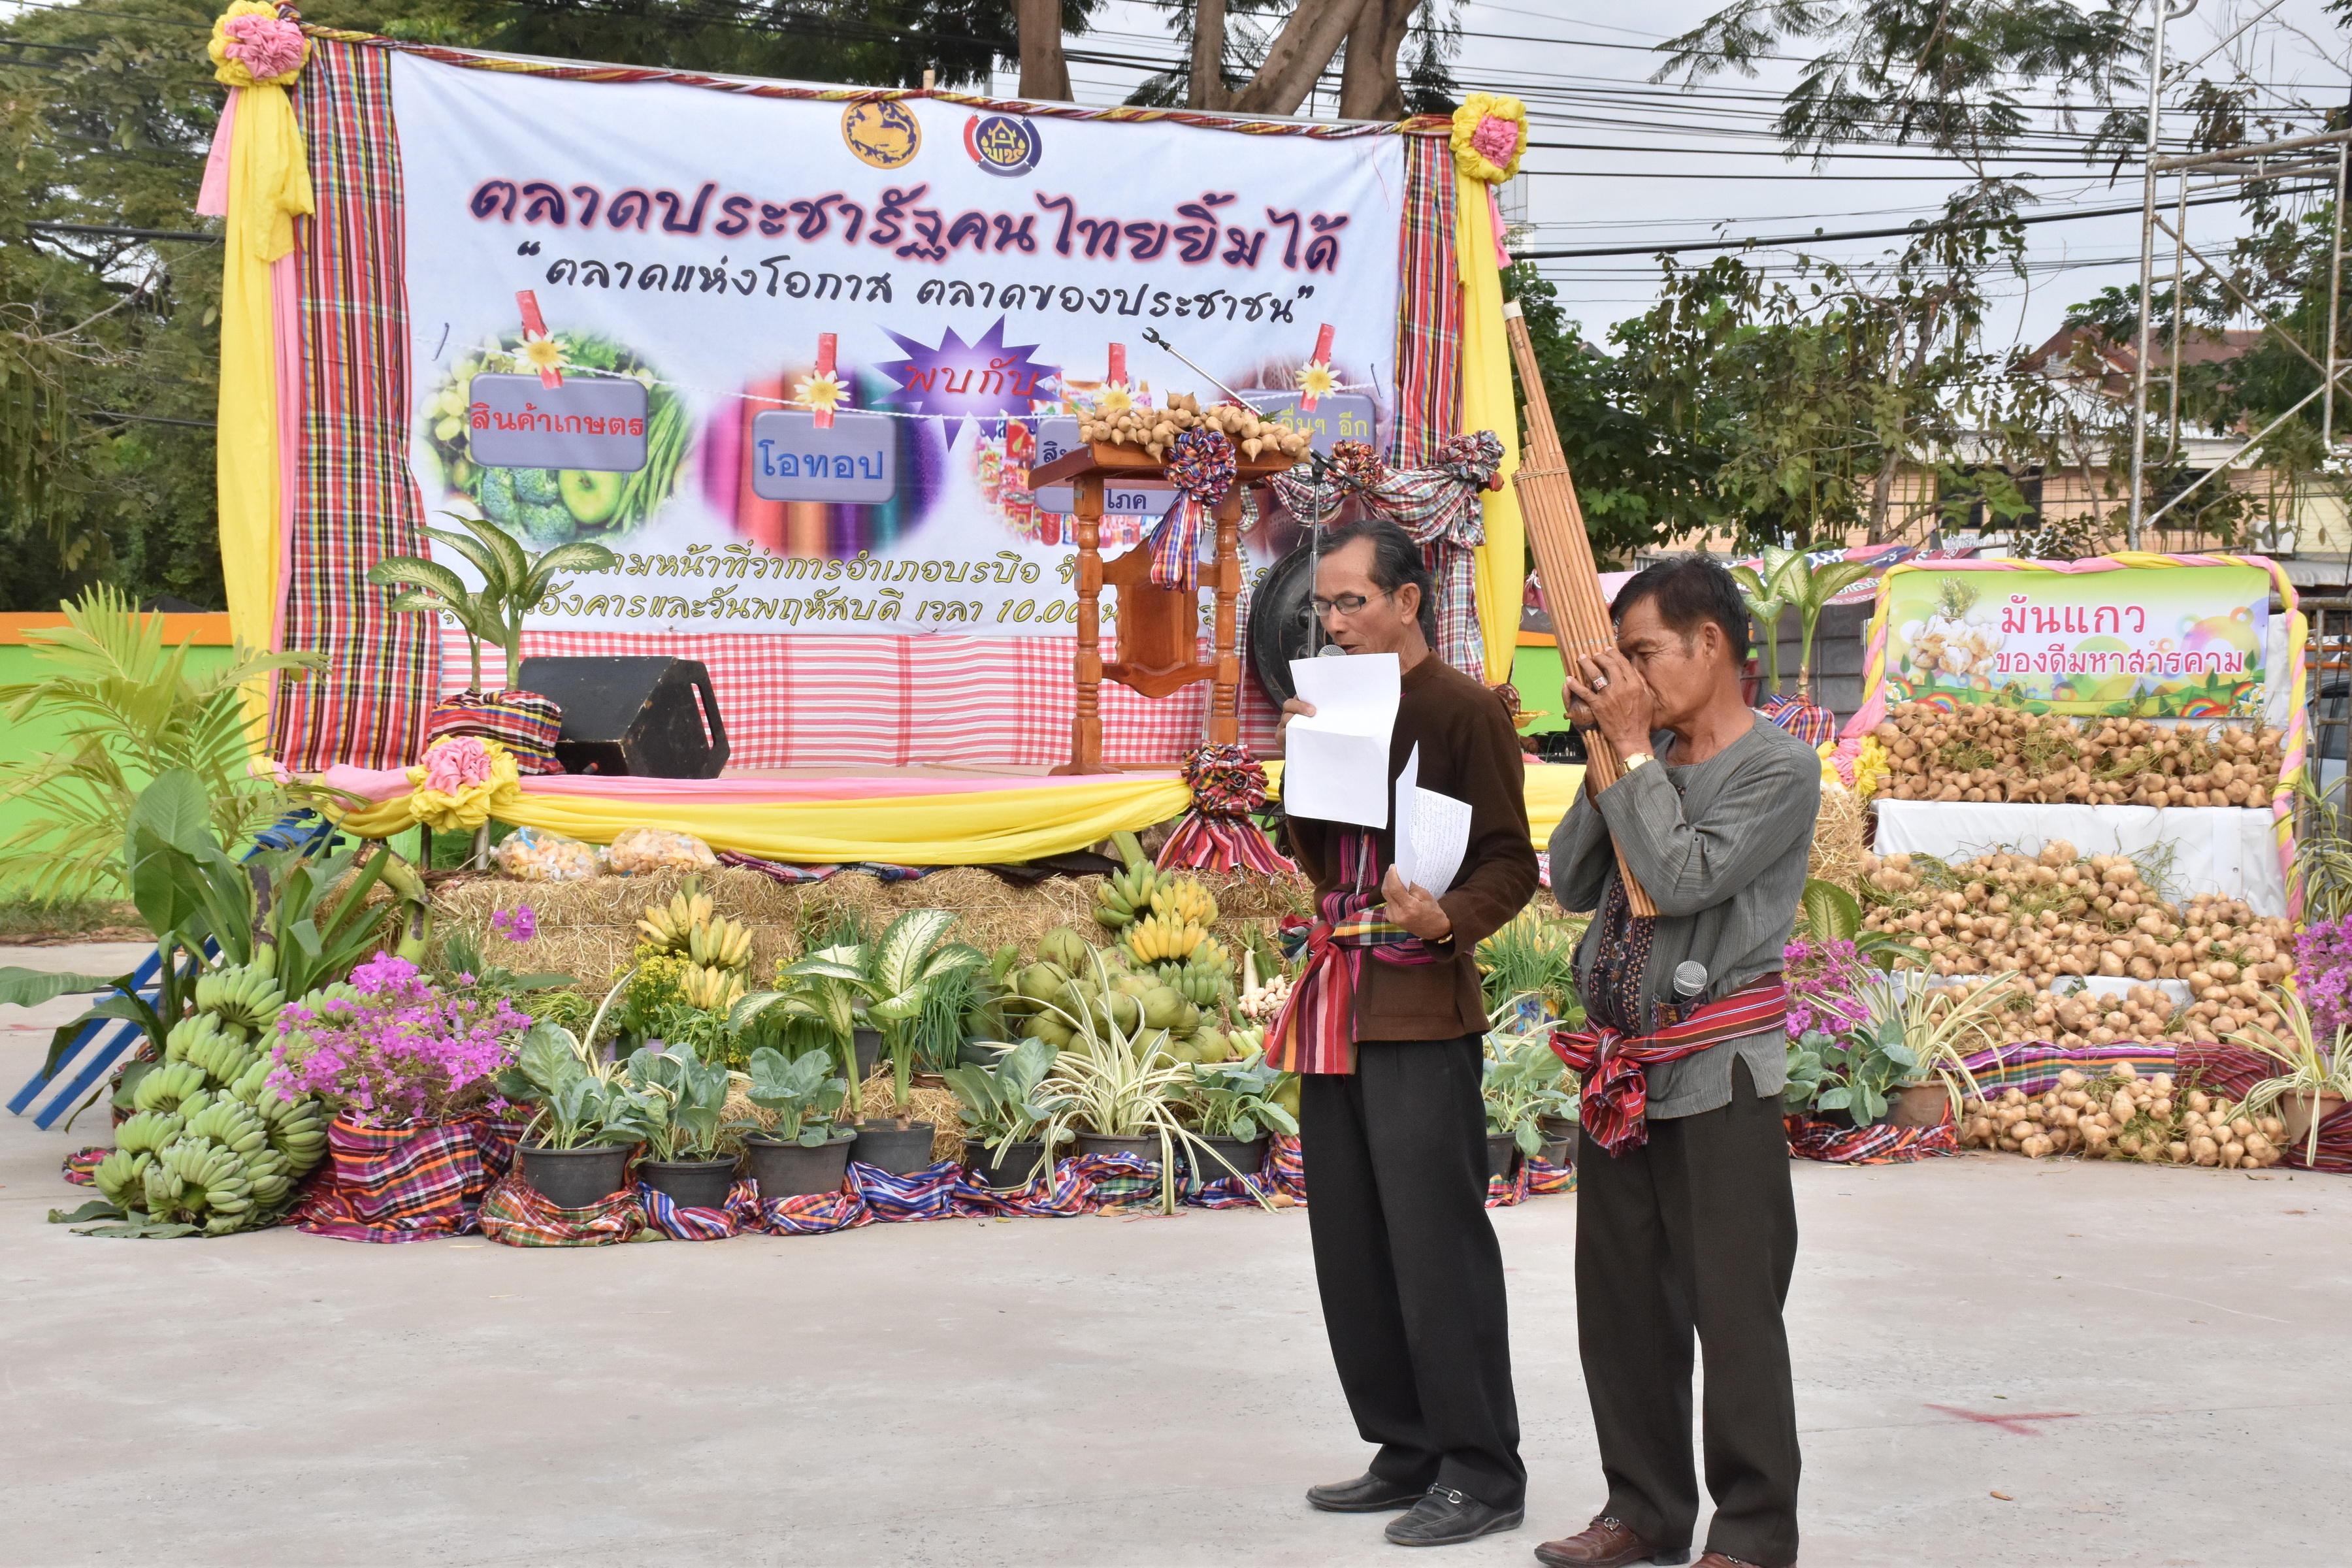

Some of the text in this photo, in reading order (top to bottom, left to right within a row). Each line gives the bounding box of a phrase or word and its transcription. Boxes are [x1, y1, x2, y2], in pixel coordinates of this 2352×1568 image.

[470, 180, 1348, 270] ตลาดประชารัฐคนไทยยิ้มได้
[906, 355, 1040, 396] พบกับ
[470, 402, 644, 436] สินค้าเกษตร
[1339, 411, 1369, 436] อีก
[757, 439, 884, 480] โอทอป
[915, 598, 983, 623] เวลา
[2001, 595, 2146, 634] มันแกว
[1996, 643, 2243, 674] ของดีมหาสารคาม
